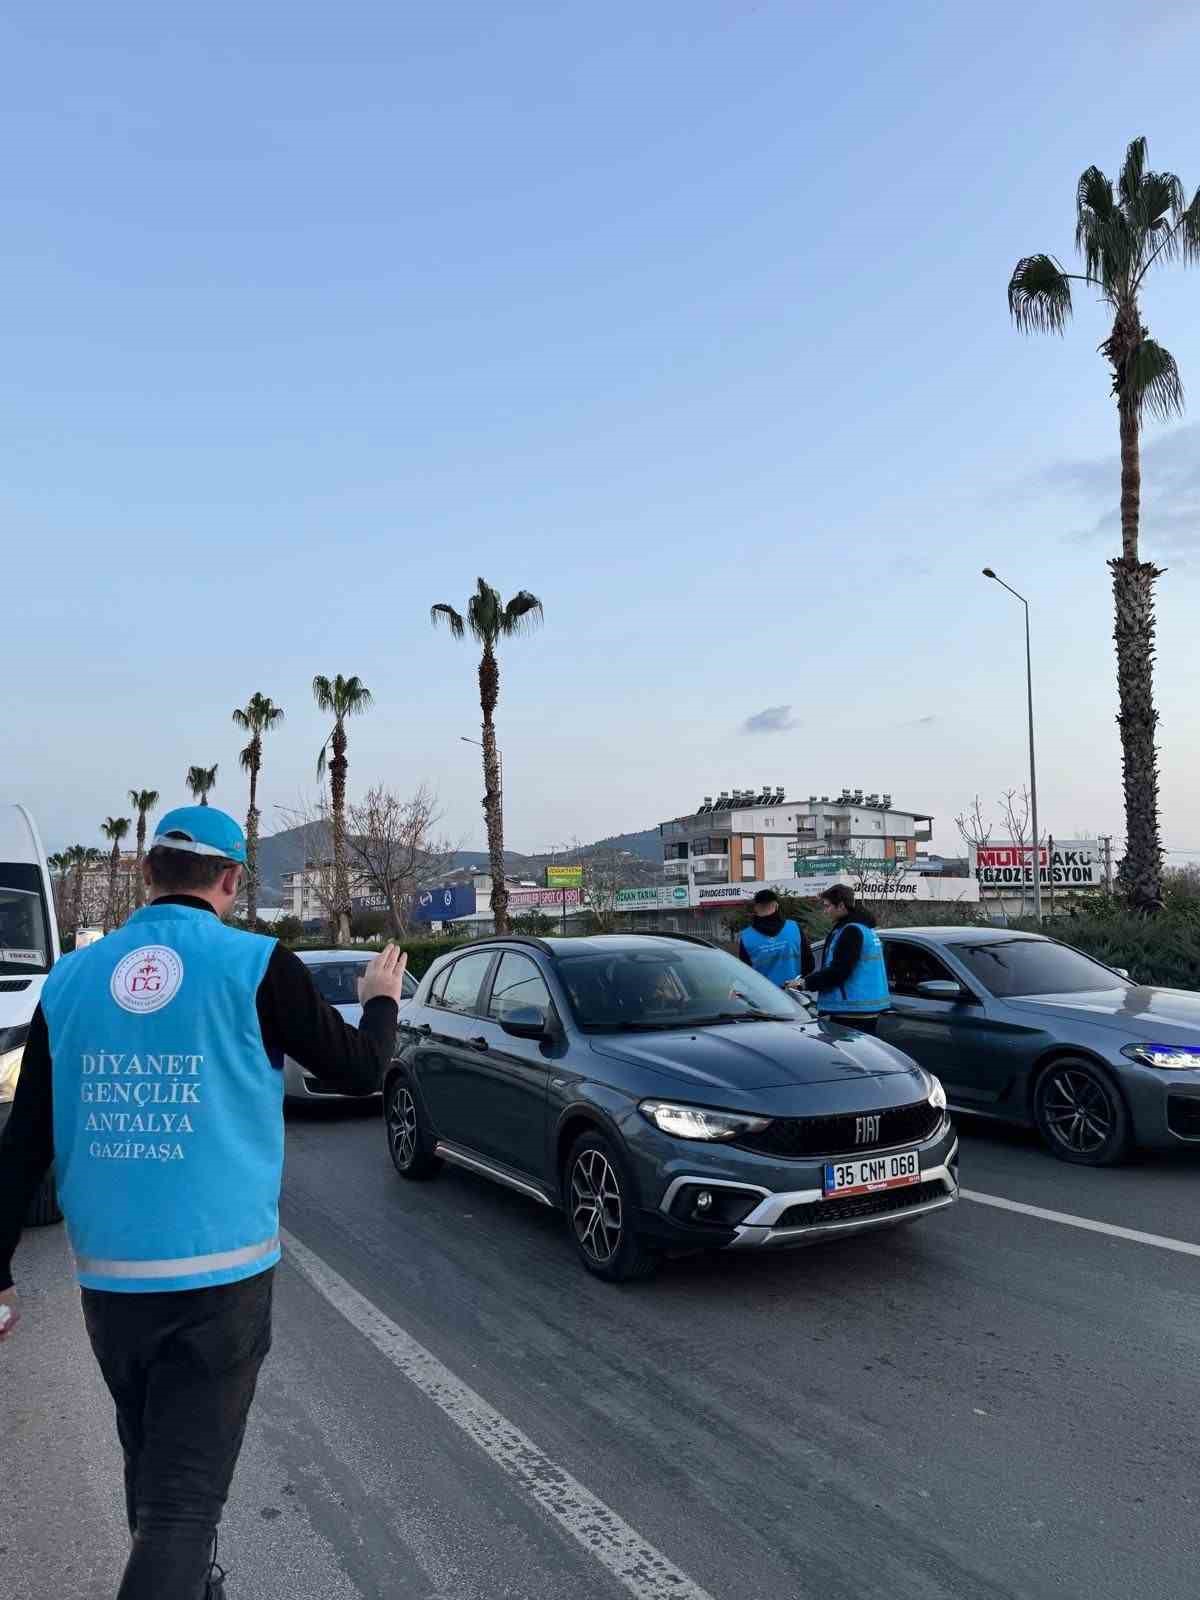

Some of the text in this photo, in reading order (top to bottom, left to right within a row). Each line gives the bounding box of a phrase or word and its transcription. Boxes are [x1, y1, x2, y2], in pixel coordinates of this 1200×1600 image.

[1053, 850, 1092, 866] AKÜ
[699, 887, 741, 898] BRIDGESTONE
[854, 882, 918, 894] BRIDGESTONE
[80, 1050, 204, 1075] DİYANET
[81, 1079, 201, 1106] GENÇLİK
[85, 1113, 194, 1133] ANTALYA
[855, 1115, 881, 1144] FIAT
[89, 1140, 185, 1162] GAZİPAŞA
[836, 1165, 855, 1187] 35
[860, 1160, 886, 1182] CNM
